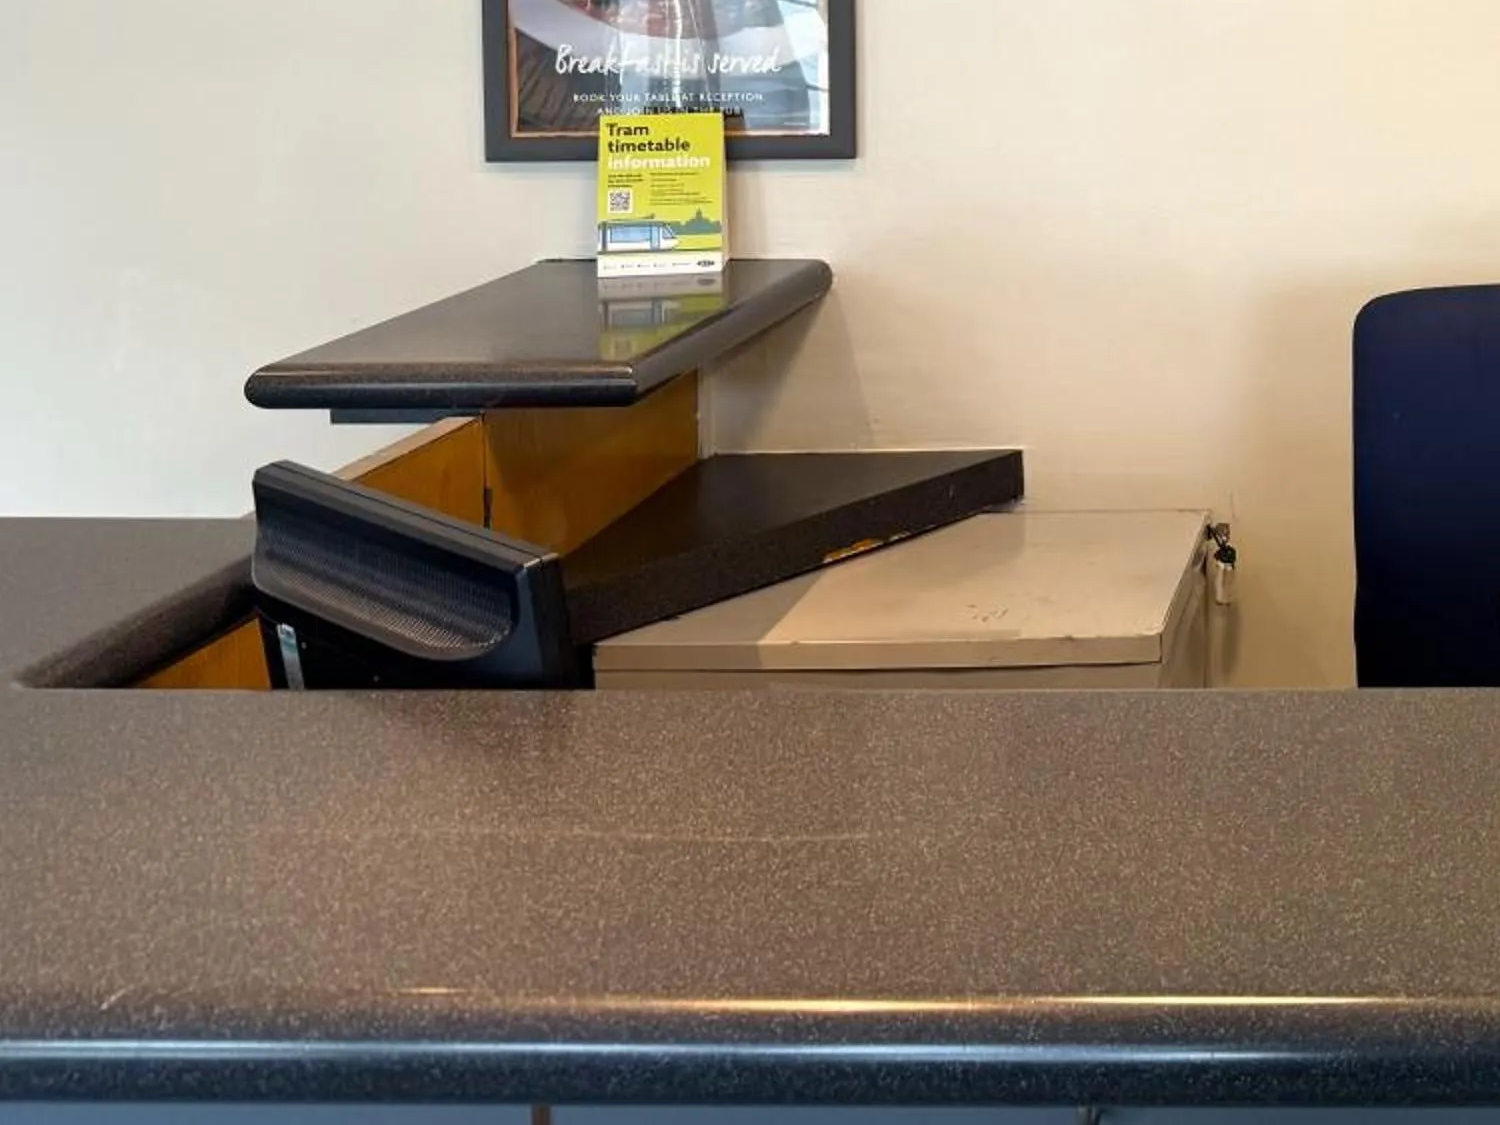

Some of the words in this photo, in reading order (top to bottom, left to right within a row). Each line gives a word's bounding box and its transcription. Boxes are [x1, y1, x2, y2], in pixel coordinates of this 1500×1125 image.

[555, 43, 670, 85] Breakfast
[707, 46, 783, 75] served
[609, 92, 640, 102] YOUR
[681, 92, 695, 102] AT
[699, 92, 764, 102] RECEPTION
[606, 122, 650, 137] Tram
[607, 136, 691, 153] timetable
[607, 155, 711, 171] information
